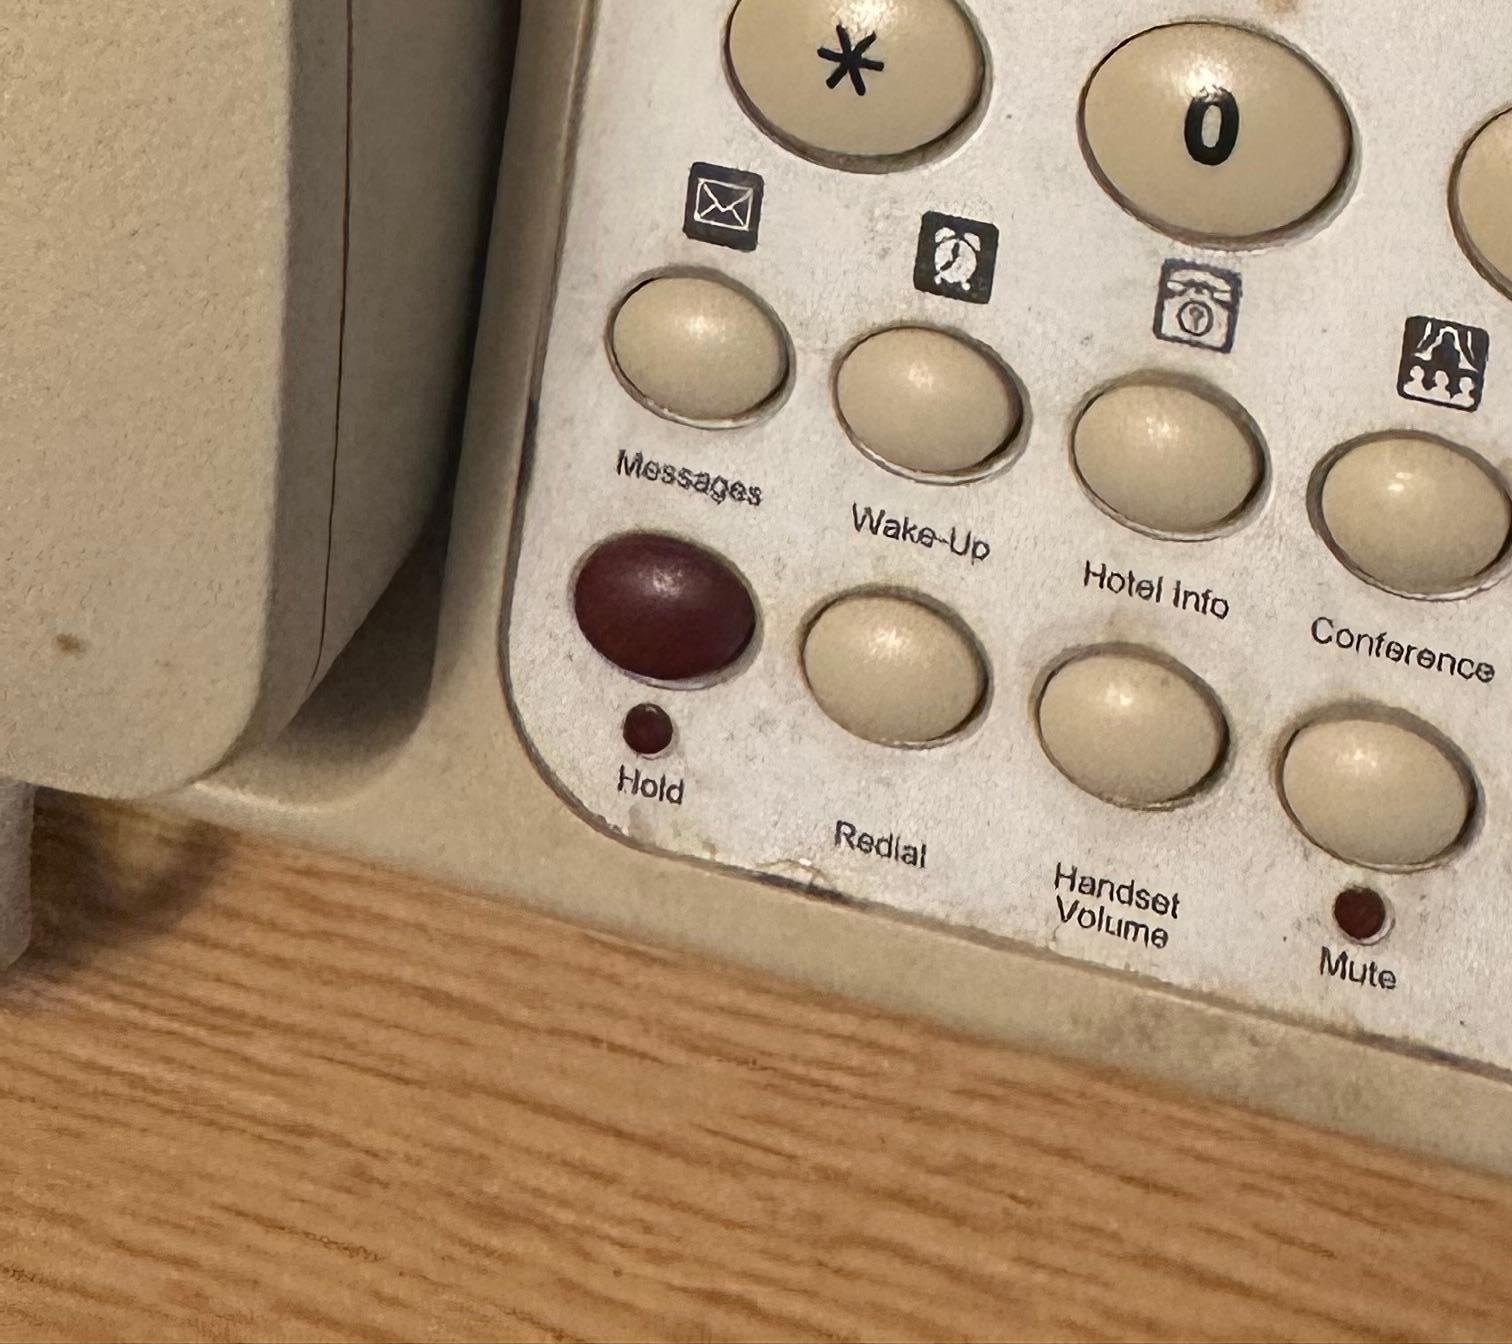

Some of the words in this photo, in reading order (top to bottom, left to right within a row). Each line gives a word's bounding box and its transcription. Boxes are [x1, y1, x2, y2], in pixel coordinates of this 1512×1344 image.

[1184, 86, 1240, 166] 0
[616, 448, 763, 507] Messages
[852, 502, 991, 561] Wake-Up
[1083, 560, 1165, 604] Hotel
[1172, 578, 1230, 621] Info
[1311, 616, 1496, 684] Conference
[617, 765, 684, 805] Hold
[834, 819, 927, 870] Redial
[1053, 861, 1180, 919] Handset
[1056, 896, 1169, 951] Volume
[1319, 945, 1397, 991] Mute
